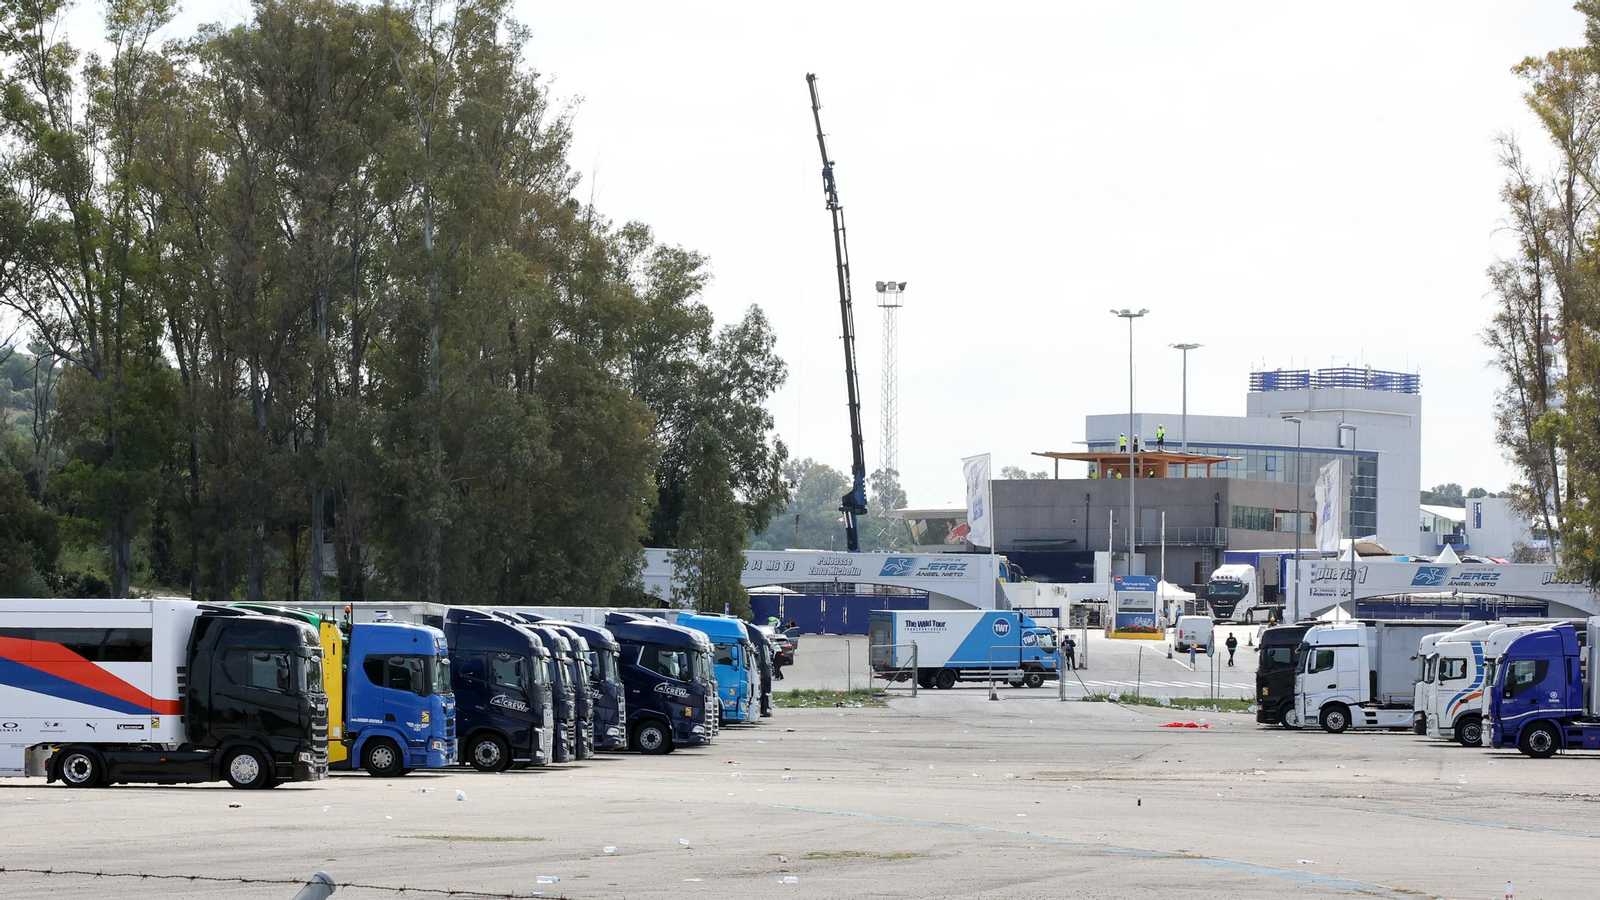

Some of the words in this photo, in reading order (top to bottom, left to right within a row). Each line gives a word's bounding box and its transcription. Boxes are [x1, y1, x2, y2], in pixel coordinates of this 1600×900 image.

[766, 560, 780, 571] M6
[783, 560, 795, 571] T8
[817, 556, 852, 566] Pelousse
[808, 566, 827, 575] Zona
[828, 567, 861, 576] Michelin
[919, 563, 968, 571] JEREZ
[1358, 565, 1368, 584] 1
[1451, 572, 1501, 580] JEREZ
[905, 620, 917, 628] The
[994, 624, 1009, 632] TWT
[1022, 634, 1036, 644] TWT
[666, 688, 686, 697] CREW
[503, 700, 525, 711] CREW
